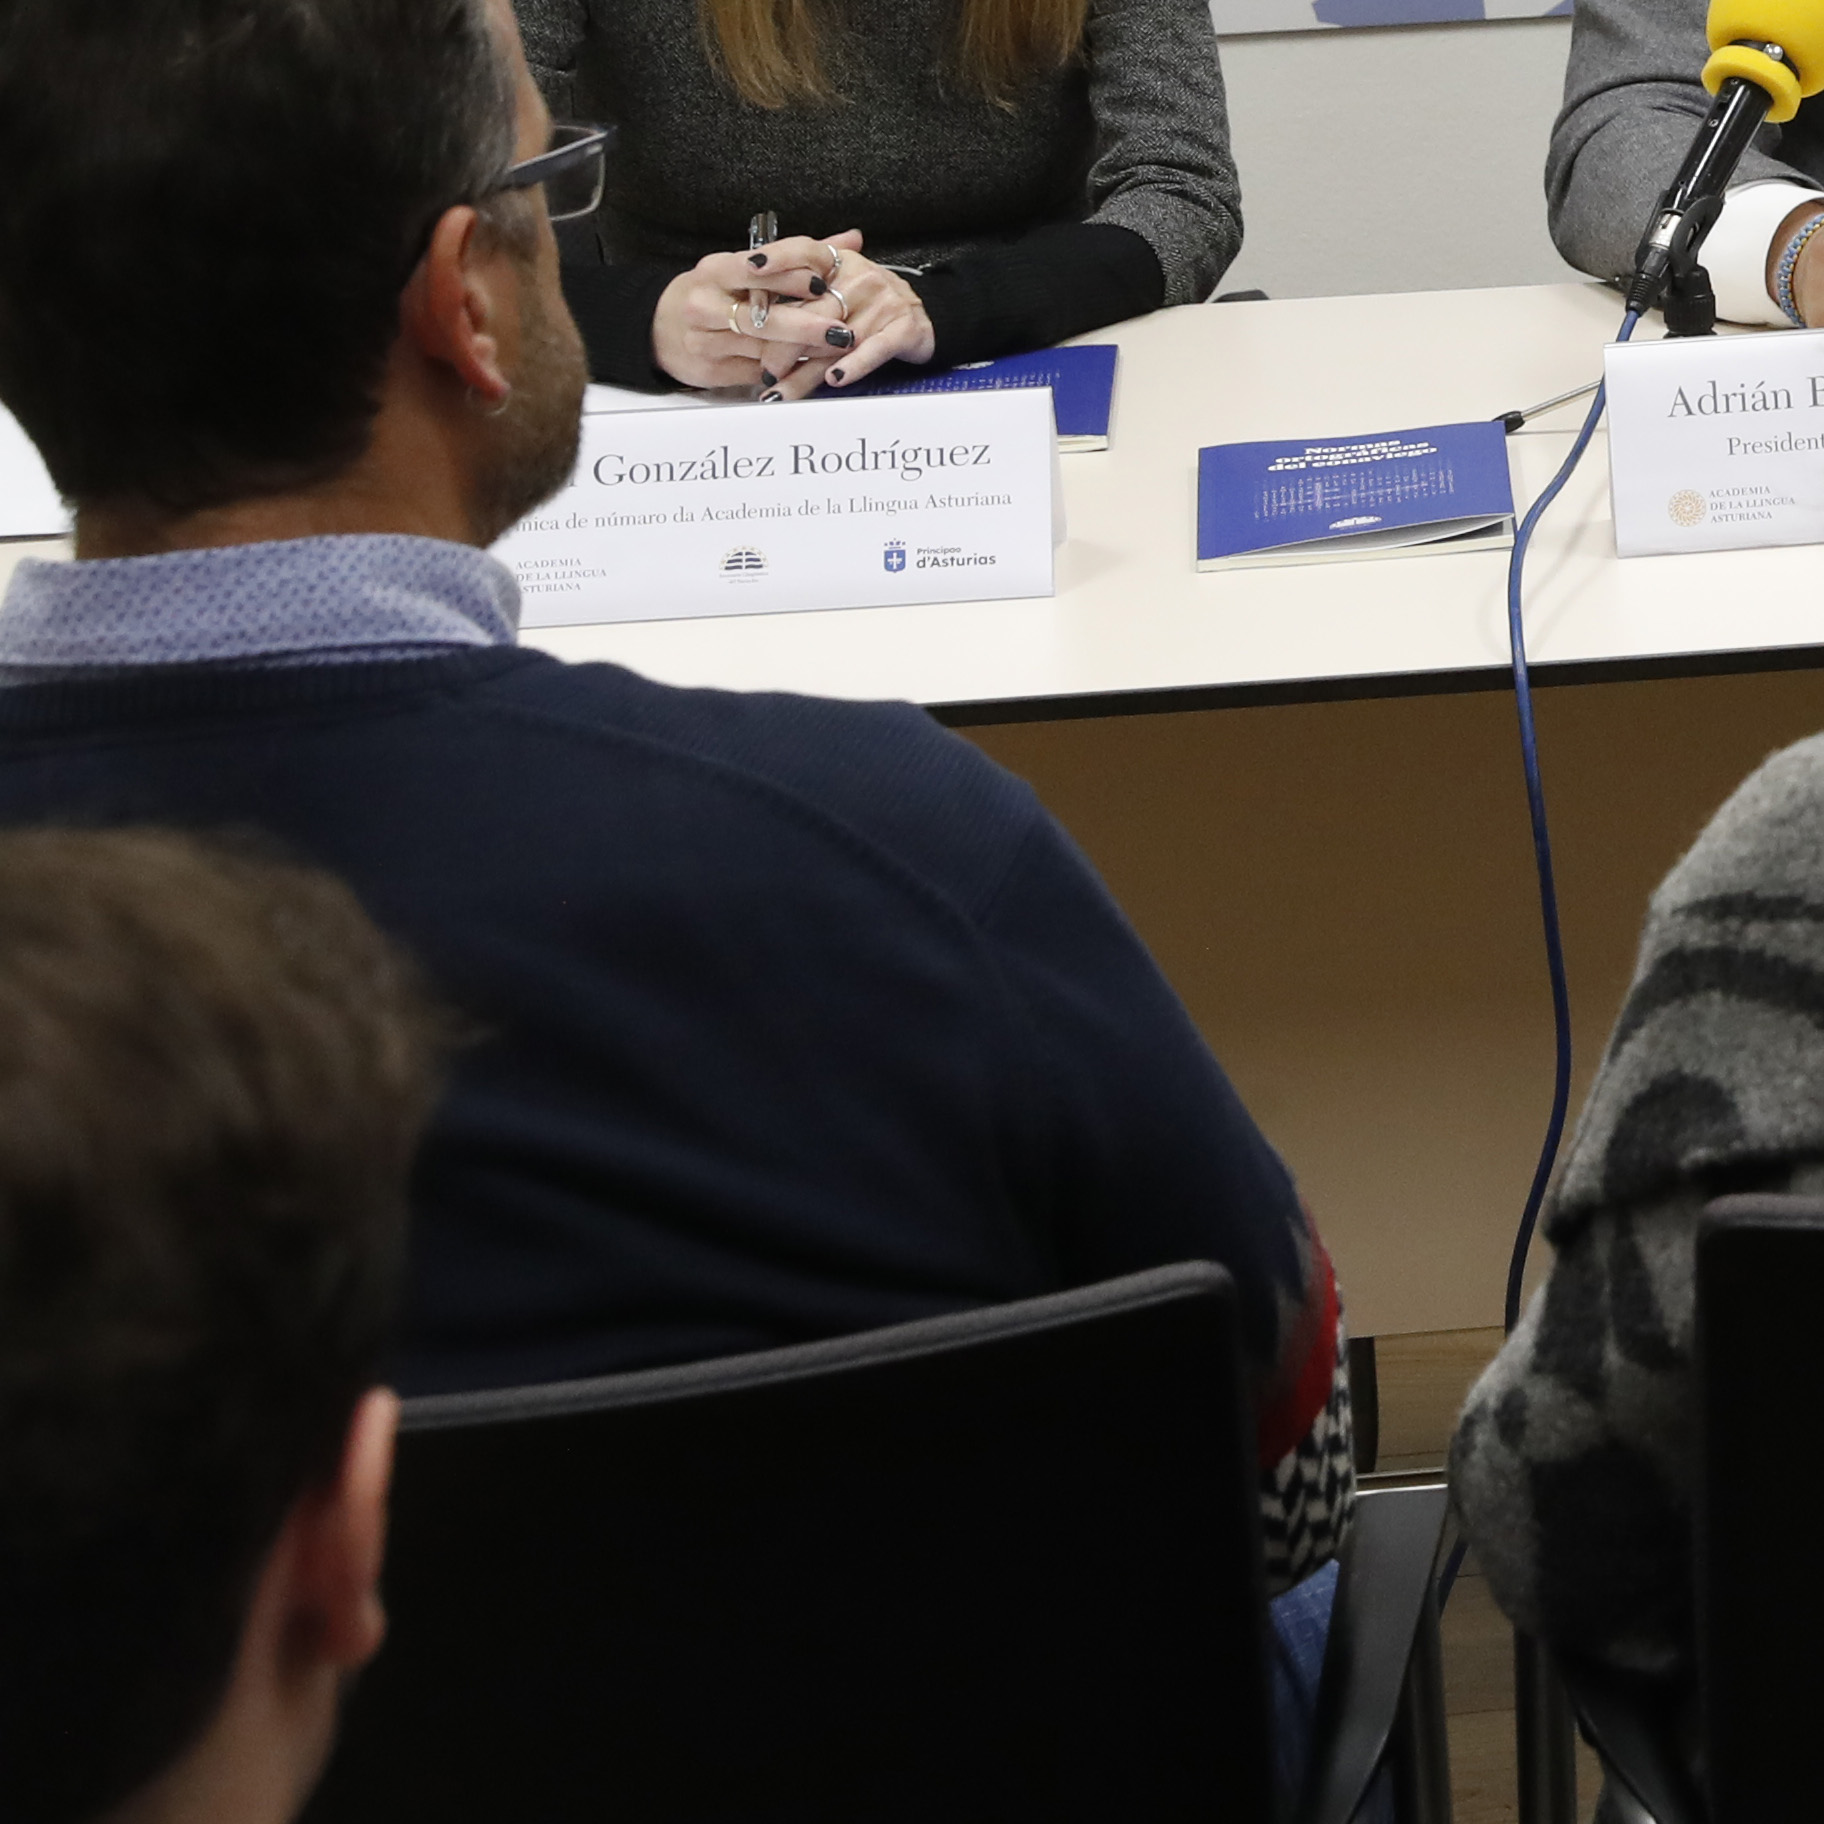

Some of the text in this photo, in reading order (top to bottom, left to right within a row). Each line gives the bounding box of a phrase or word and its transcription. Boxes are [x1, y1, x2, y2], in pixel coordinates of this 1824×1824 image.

[1666, 379, 1795, 418] Adrián
[1304, 439, 1401, 454] Normas
[592, 445, 776, 487] González
[789, 437, 992, 482] Rodríguez
[1708, 485, 1771, 499] ACADEMIA
[565, 512, 589, 528] de
[594, 510, 668, 528] númaro
[672, 505, 696, 524] da
[701, 501, 793, 522] Academia
[797, 498, 822, 517] de
[826, 497, 843, 515] la
[848, 494, 920, 517] Llingua
[925, 491, 1013, 510] Asturiana
[1710, 497, 1796, 512] DE LA LLINGUA
[1710, 511, 1773, 524] ASTURIANA
[515, 557, 582, 570] ACADEMIA
[916, 552, 997, 570] d'Asturias
[536, 570, 552, 582] LA
[554, 568, 607, 581] LLINGUA
[521, 582, 583, 594] STURIANA
